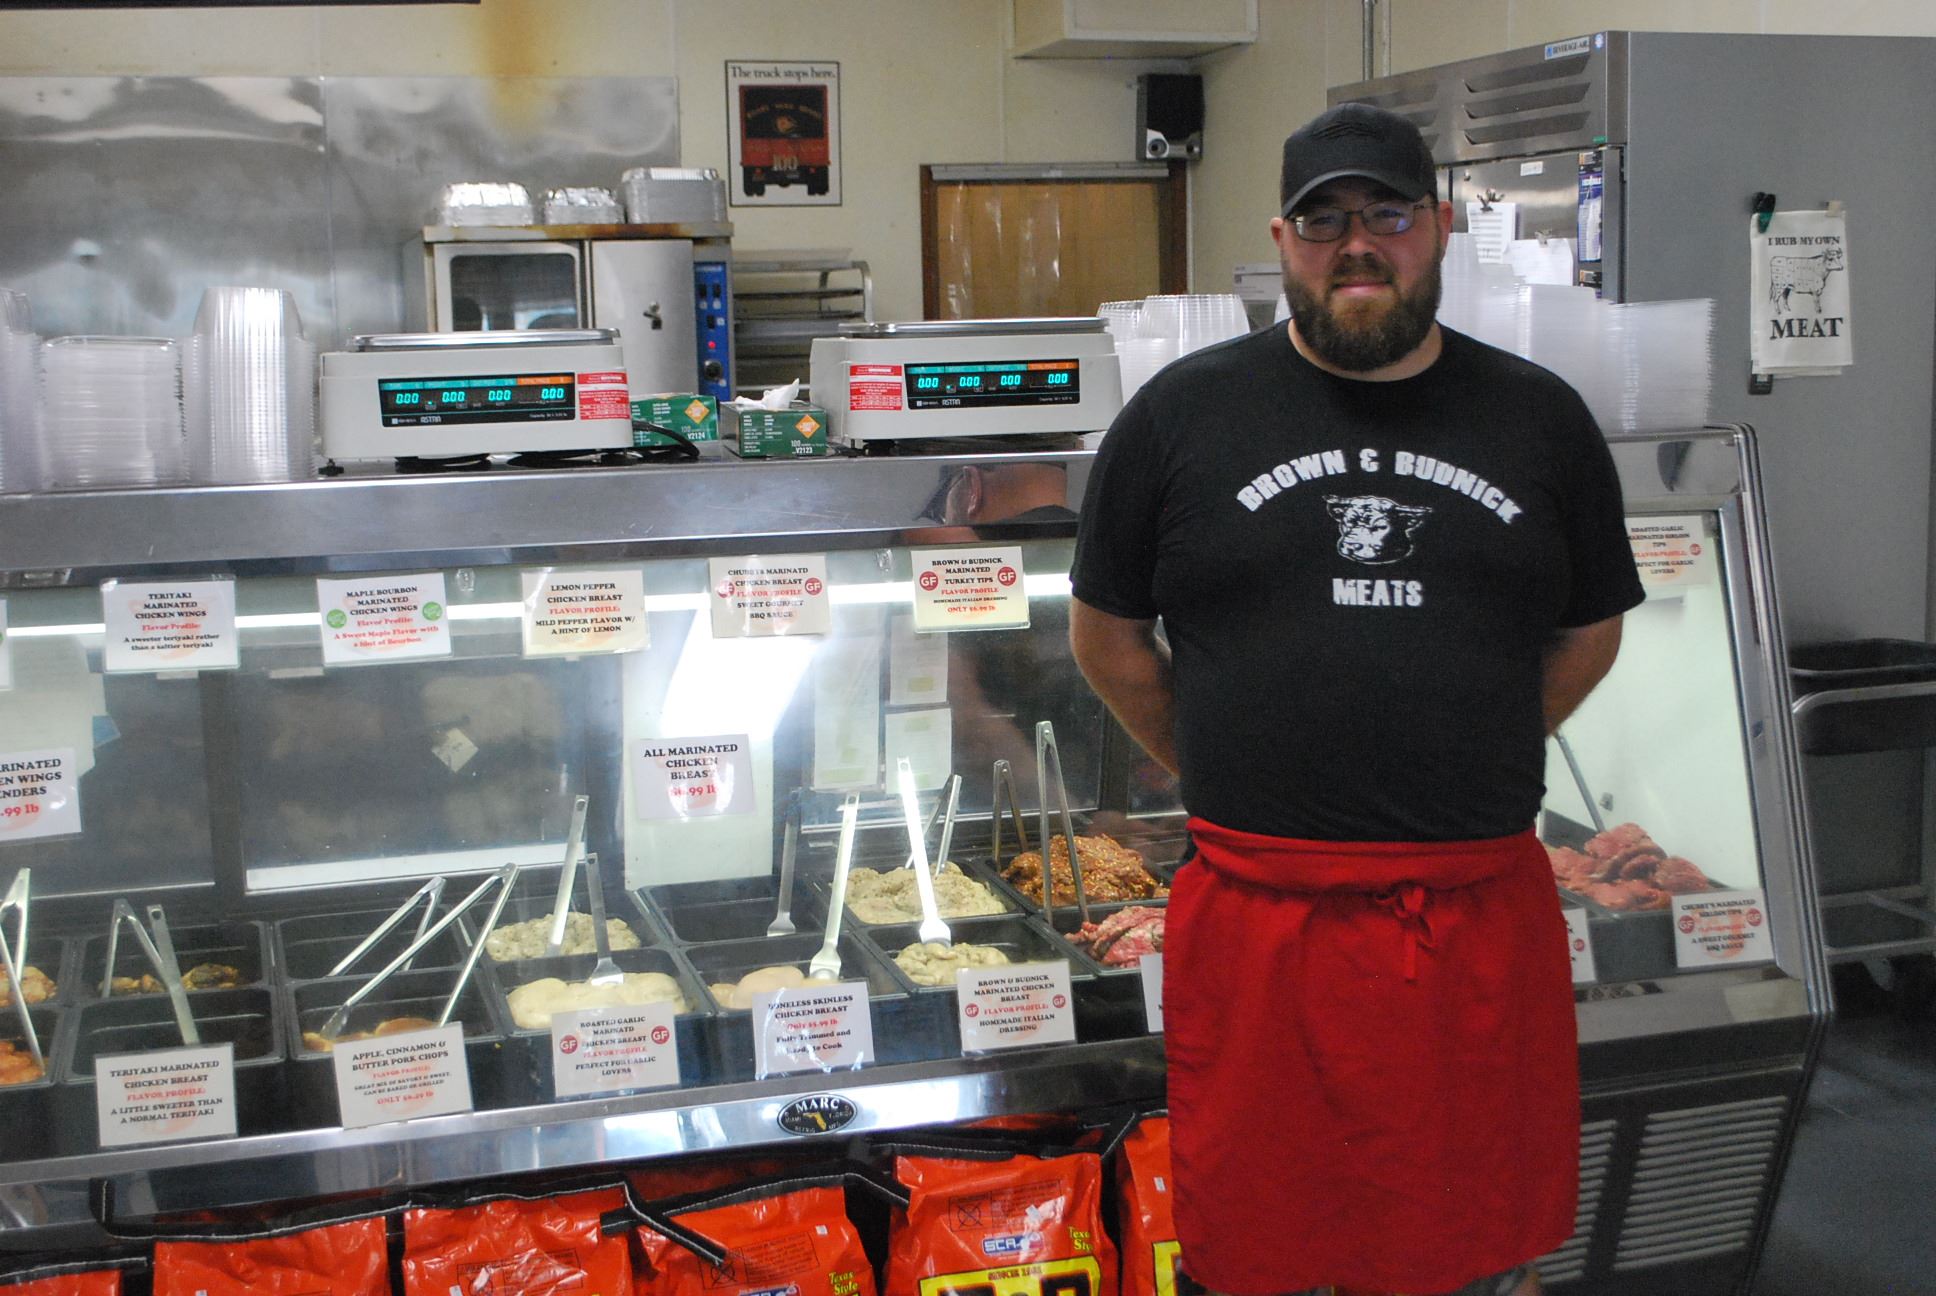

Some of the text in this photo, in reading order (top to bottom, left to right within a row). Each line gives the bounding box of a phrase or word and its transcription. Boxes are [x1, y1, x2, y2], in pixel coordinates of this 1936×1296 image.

[731, 66, 751, 78] The
[754, 67, 781, 78] truck
[784, 69, 808, 82] stops
[1775, 237, 1797, 245] RUB
[1800, 237, 1813, 245] MY
[1770, 318, 1843, 340] MEAT
[1237, 450, 1347, 512] BROWN
[1395, 451, 1523, 525] BUDNICK
[921, 577, 936, 586] GF
[999, 573, 1015, 581] GF
[377, 587, 417, 595] BOURBON
[1332, 578, 1422, 606] MEATS
[358, 597, 408, 606] MARINATED
[644, 744, 738, 757] ALL MARINATED
[0, 759, 61, 772] RINATED
[18, 772, 61, 783] WINGS
[671, 770, 715, 780] BREAS
[26, 804, 39, 813] lb
[1015, 975, 1049, 983] BUDNICK
[974, 987, 1020, 995] MARINATED
[813, 995, 853, 1005] SKINLESS
[1001, 994, 1030, 1002] BREAST
[775, 1006, 848, 1019] CHICKEN BREAST
[984, 1007, 1014, 1015] FLAVOR
[581, 1016, 646, 1028] ROASTED GARLIC
[980, 1014, 1055, 1026] HOMEMADE ITALIAN
[999, 1025, 1037, 1033] DRESSING
[653, 1031, 667, 1040] GF
[386, 1043, 436, 1055] CINNAMON
[561, 1040, 576, 1049] GF
[353, 1051, 448, 1071] BUTTER PORK CHOPS
[576, 1062, 609, 1070] PERFECT
[110, 1061, 219, 1077] TERIYAKI MARINATED
[124, 1075, 208, 1088] CHICKEN BREAST
[127, 1092, 163, 1101] FLAVOR
[152, 1101, 195, 1111] SWEETER
[198, 1098, 223, 1106] THAN
[795, 1098, 840, 1113] MARC
[130, 1114, 168, 1123] NORMAL
[171, 1109, 214, 1119] TERIYAKI
[829, 1271, 854, 1284] Texas
[834, 1281, 859, 1295] Style
